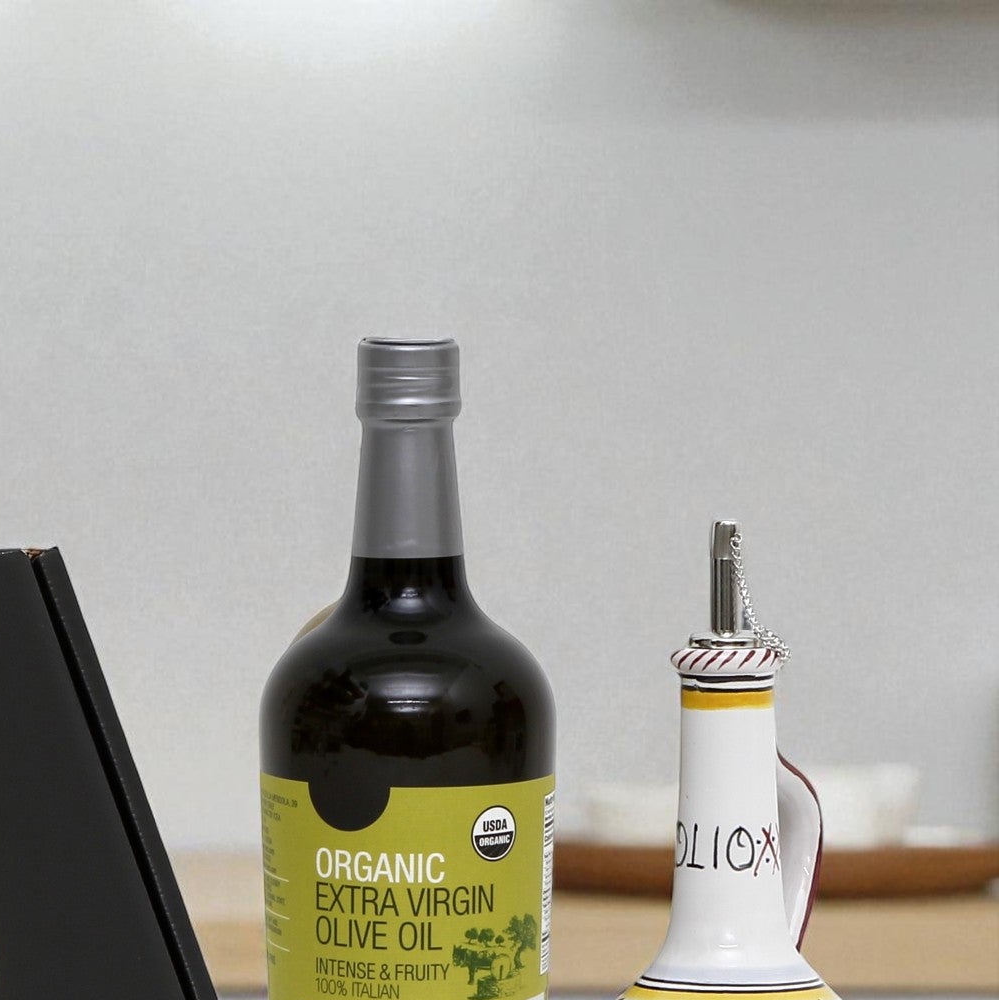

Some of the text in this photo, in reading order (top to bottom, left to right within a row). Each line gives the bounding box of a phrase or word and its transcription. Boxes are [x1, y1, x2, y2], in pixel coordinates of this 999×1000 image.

[483, 818, 508, 832] USDA
[479, 834, 511, 847] ORGANIC
[315, 847, 446, 884] ORGANIC
[316, 881, 399, 917] EXTRA
[407, 884, 494, 917] VIRGIN
[316, 915, 388, 950] OLIVE
[399, 921, 443, 951] OIL
[316, 957, 450, 981] INTENSE & FRUITY
[315, 977, 400, 999] 100% ITALIAN
